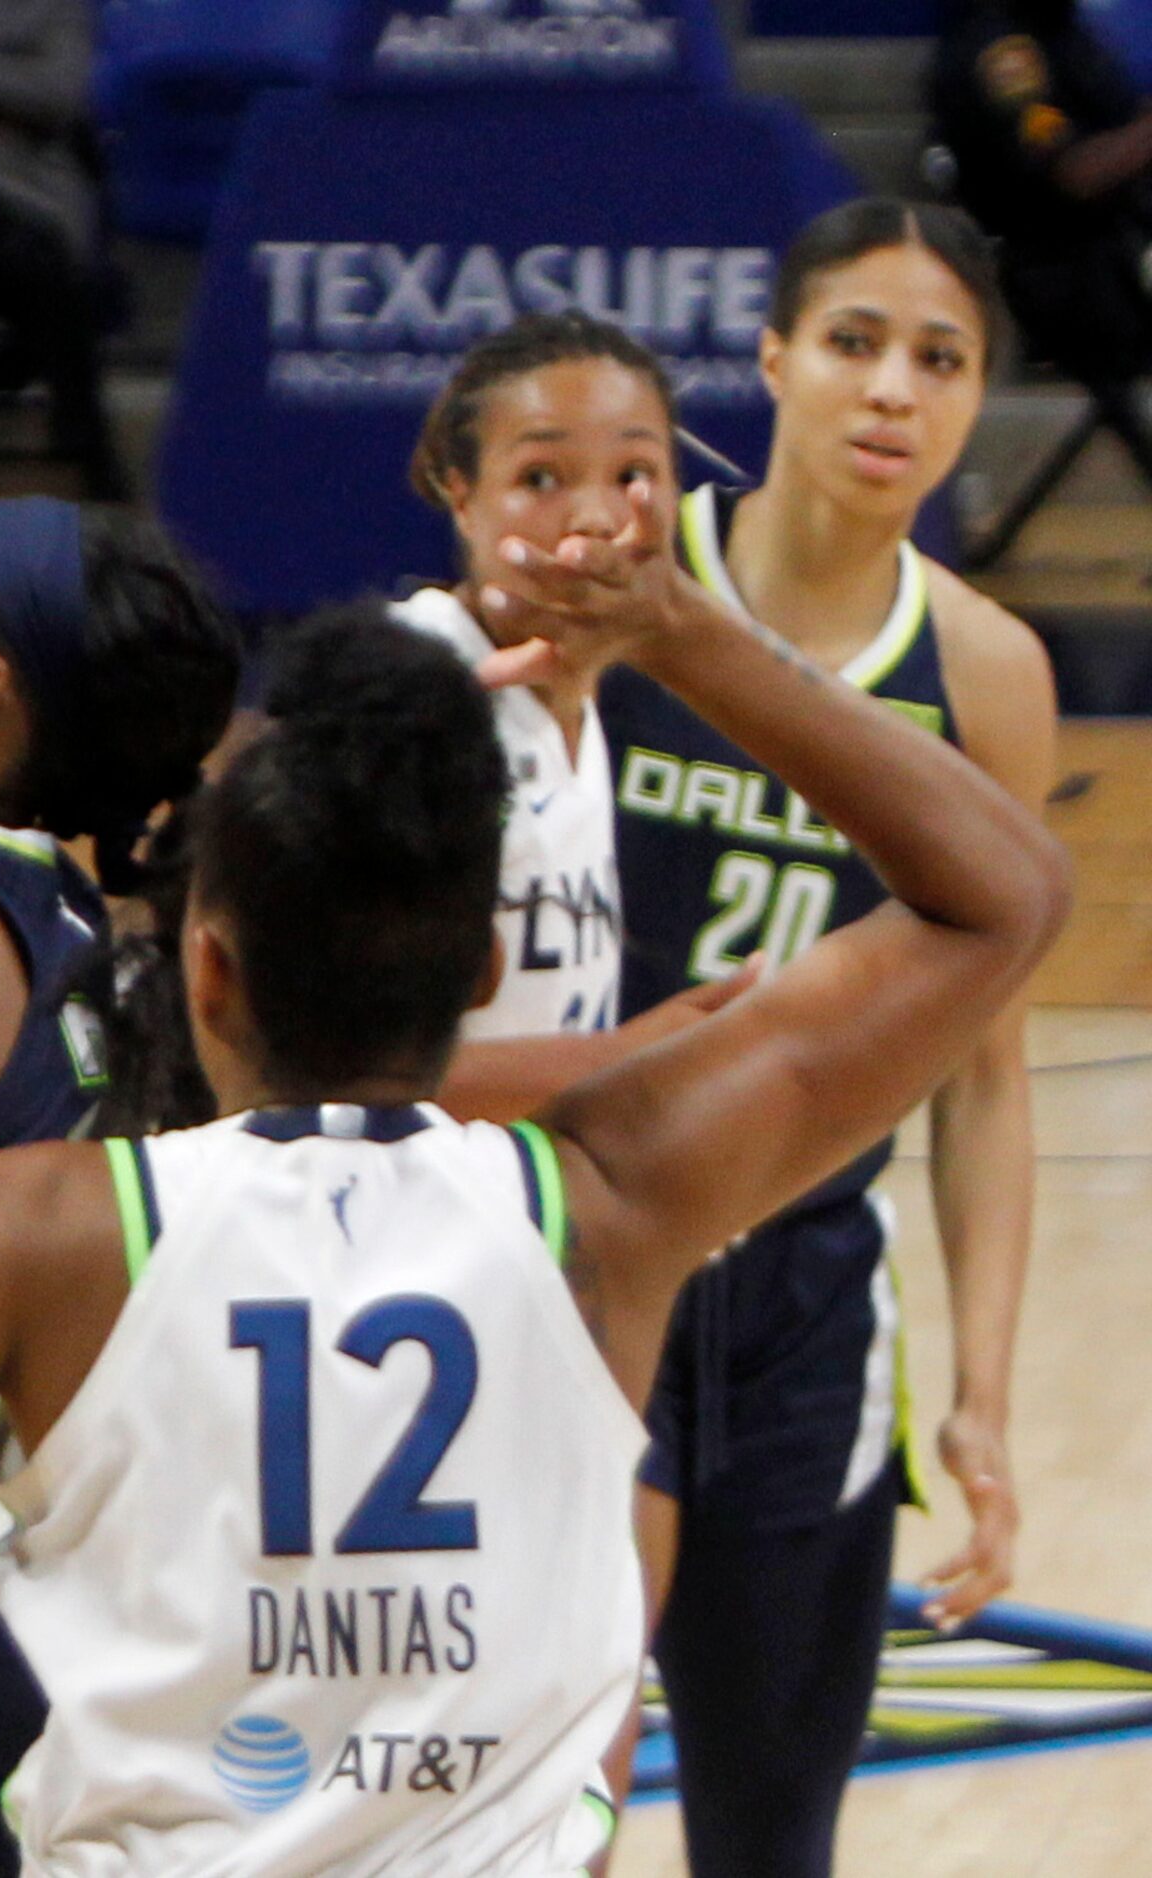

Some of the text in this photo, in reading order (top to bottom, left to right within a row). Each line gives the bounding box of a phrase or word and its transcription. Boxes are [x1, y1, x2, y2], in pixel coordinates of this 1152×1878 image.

[619, 745, 849, 854] DALL
[519, 866, 622, 970] LYN
[686, 850, 837, 987] 20
[228, 1292, 479, 1555] 12
[248, 1583, 478, 1678] DANTAS
[321, 1734, 500, 1793] AT&T
